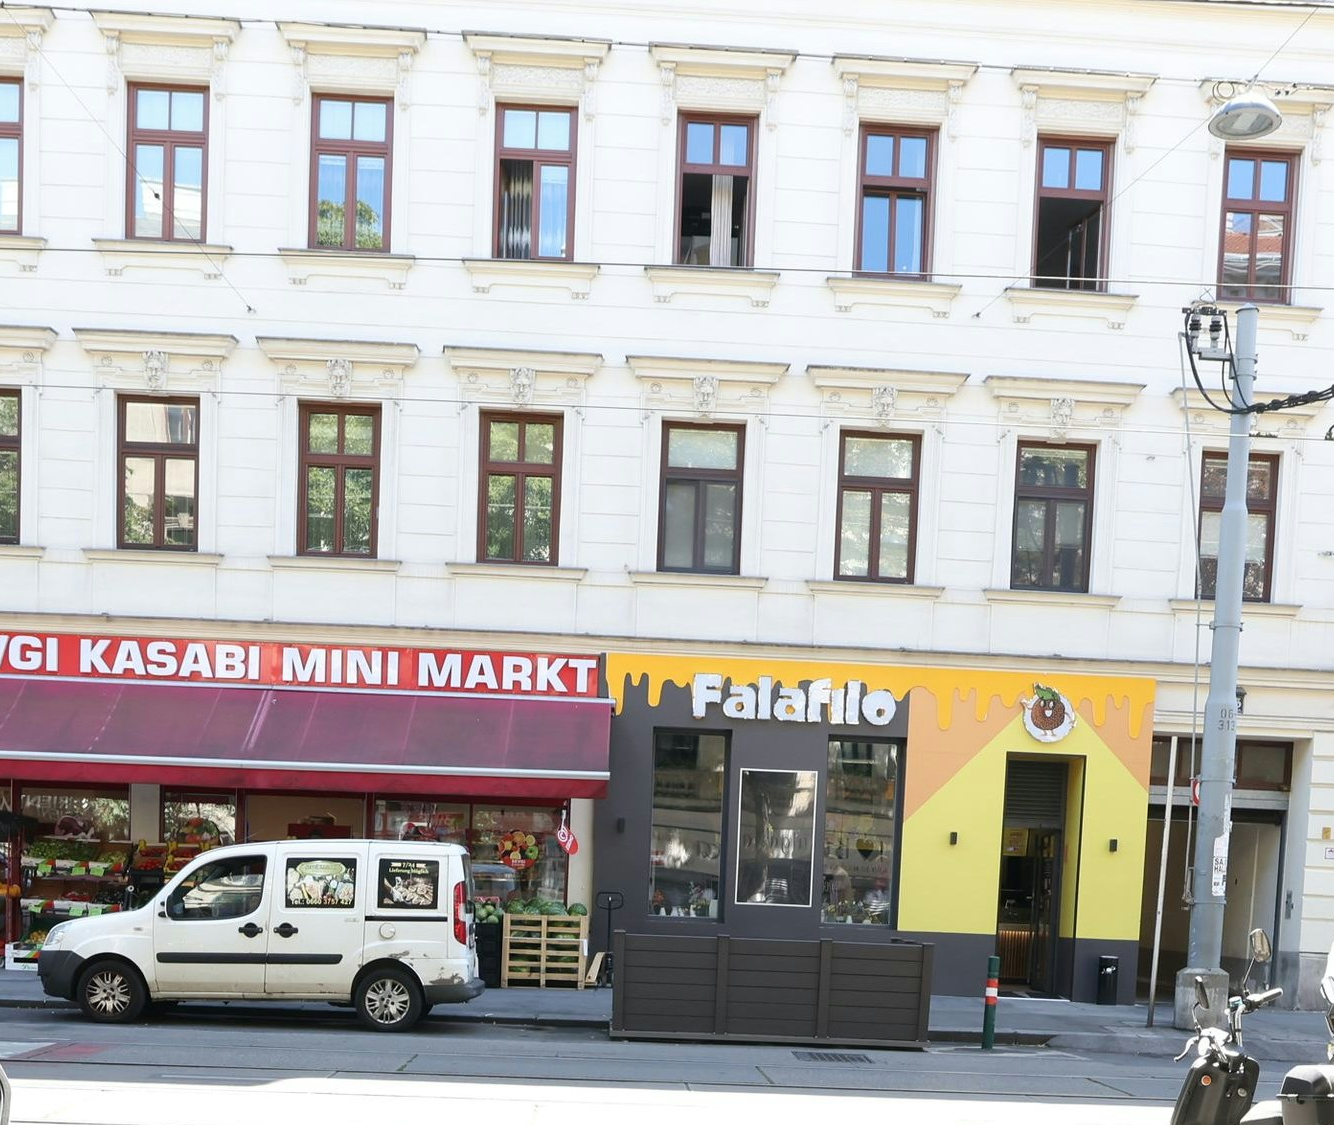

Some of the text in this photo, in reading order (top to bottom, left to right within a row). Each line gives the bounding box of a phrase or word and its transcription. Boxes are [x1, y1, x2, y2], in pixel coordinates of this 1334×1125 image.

[79, 638, 260, 681] KASABI
[282, 647, 399, 686] MINI
[417, 652, 597, 693] MARKT
[692, 673, 897, 726] Falafilo
